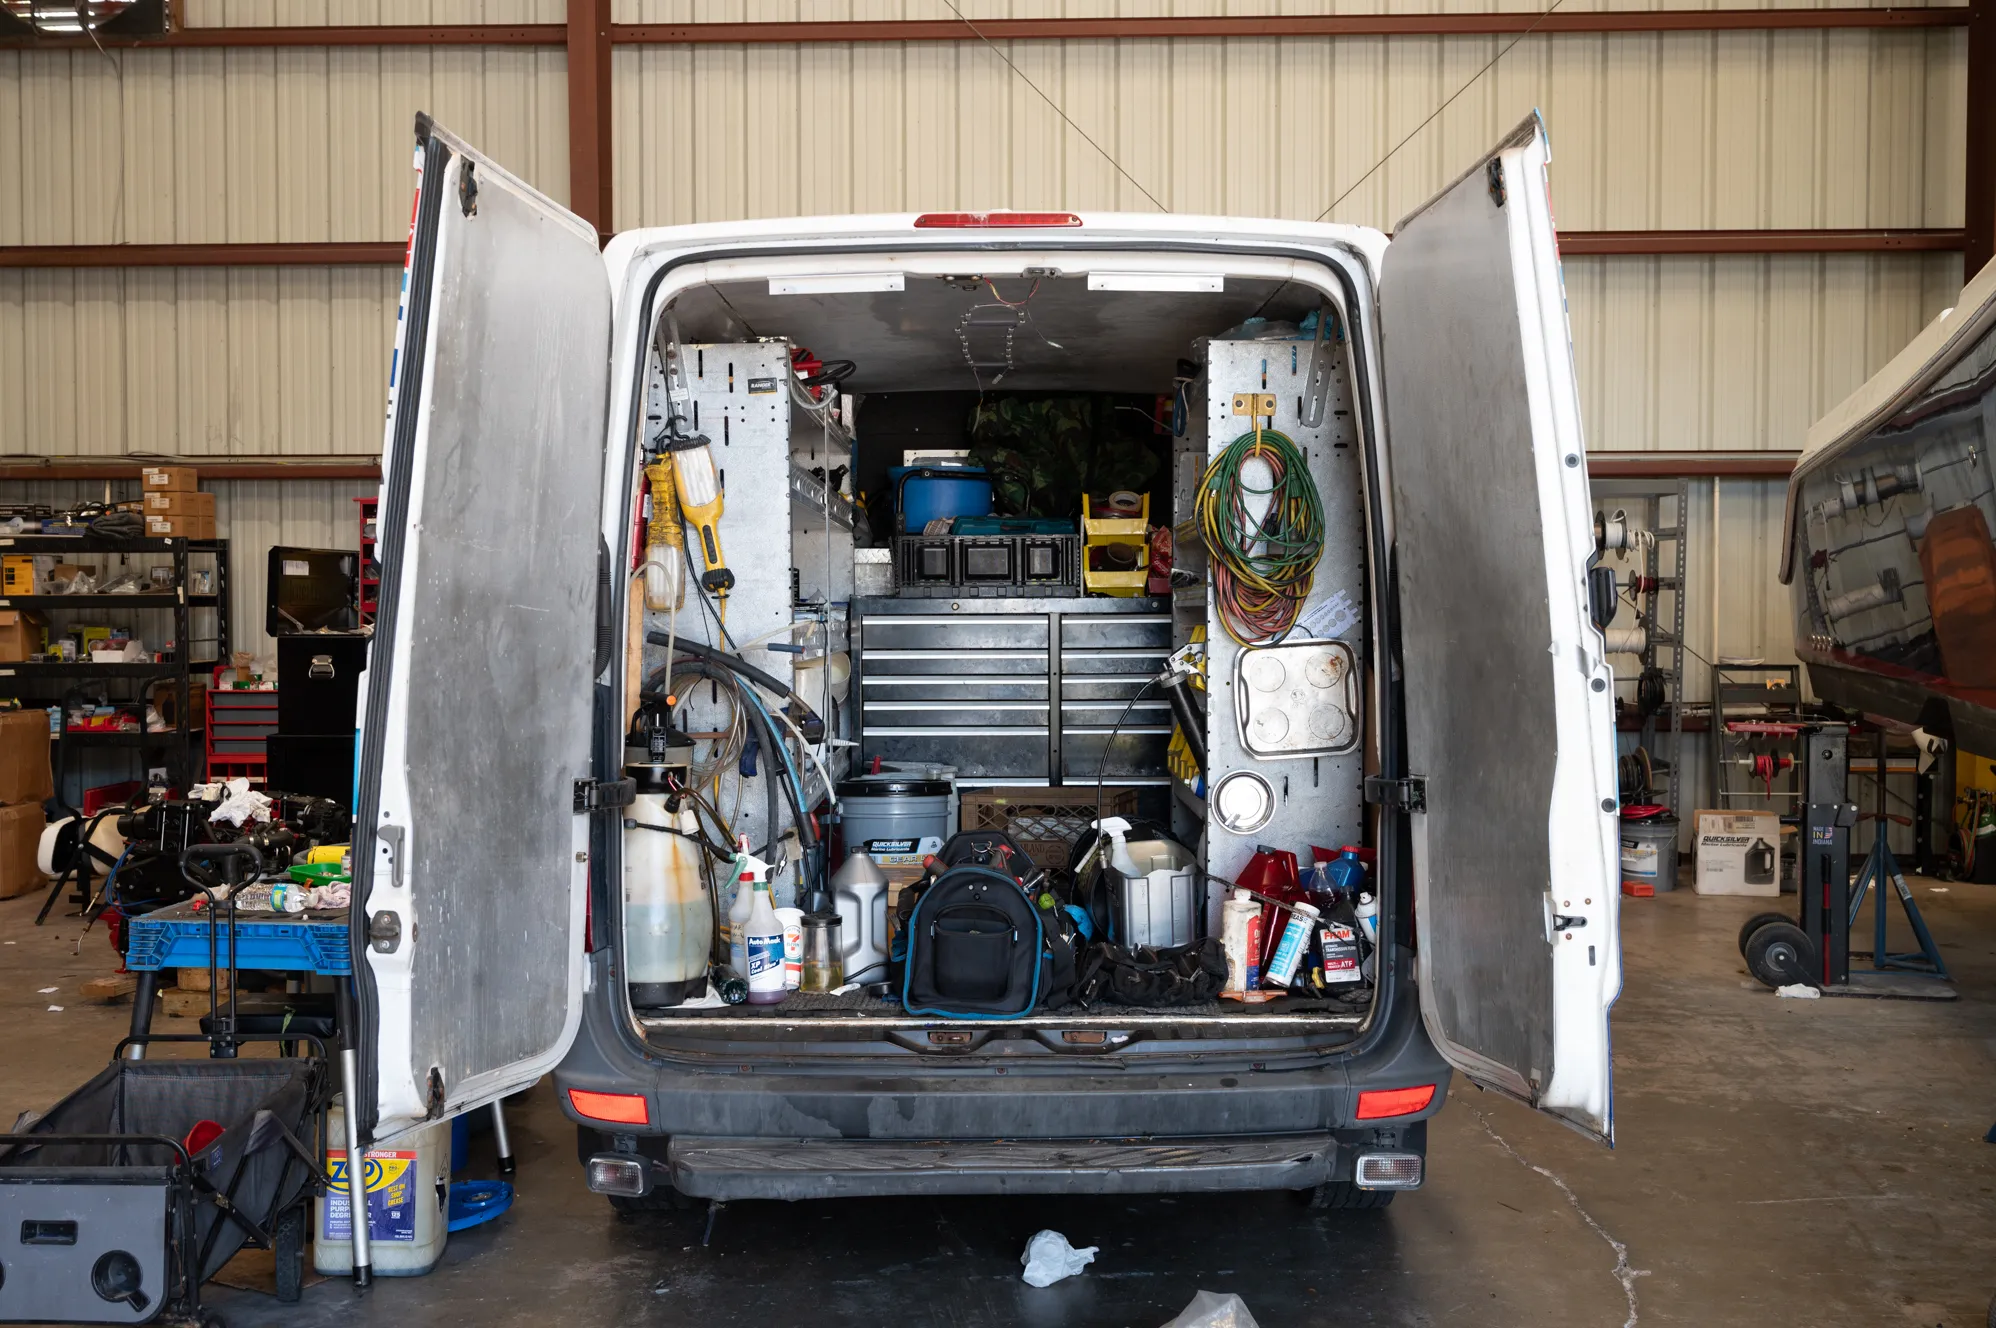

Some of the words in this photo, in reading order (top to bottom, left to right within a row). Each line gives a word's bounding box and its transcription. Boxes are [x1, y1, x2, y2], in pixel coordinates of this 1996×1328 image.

[1703, 835, 1751, 843] QUICKSILVER
[890, 855, 918, 864] GEAR
[1324, 930, 1350, 940] FRAM
[749, 937, 763, 945] Auto
[787, 934, 800, 951] 7
[751, 961, 761, 969] XP
[1341, 960, 1353, 969] ATF
[751, 966, 763, 975] Cool
